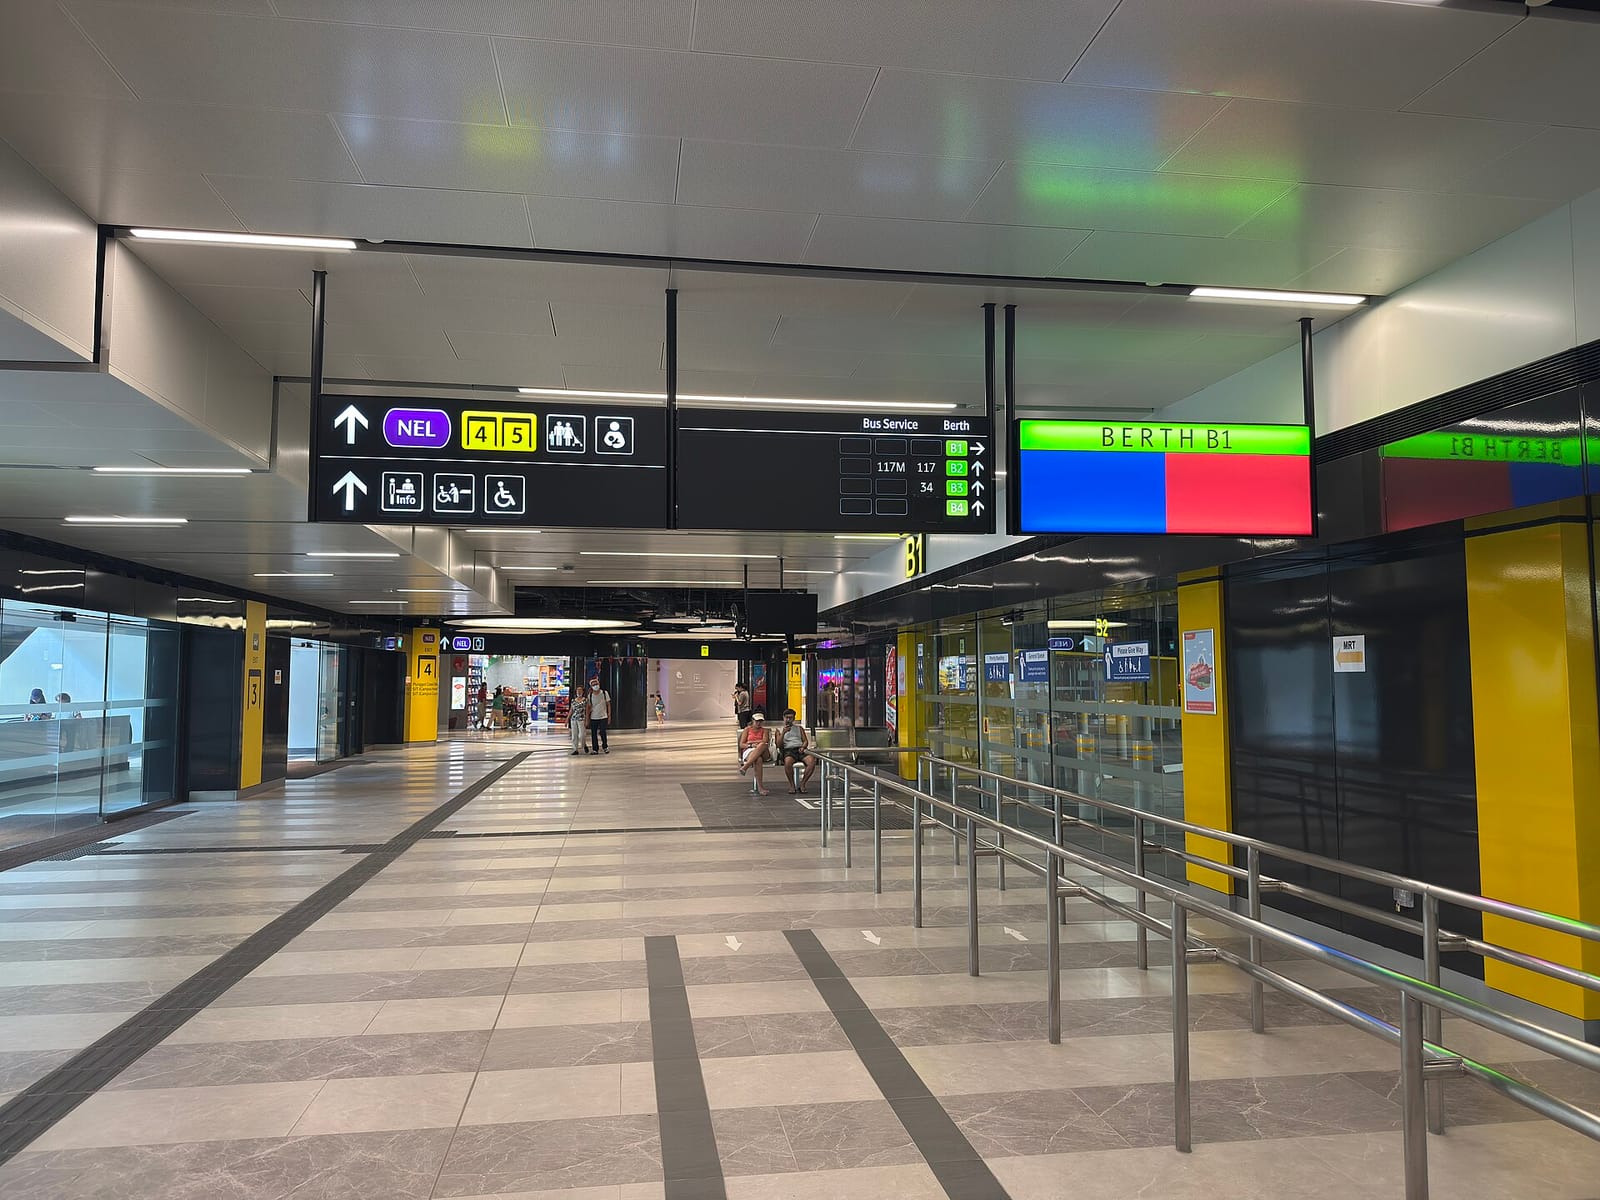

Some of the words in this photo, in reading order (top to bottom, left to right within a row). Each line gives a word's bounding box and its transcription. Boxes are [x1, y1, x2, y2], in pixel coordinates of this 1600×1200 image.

[397, 419, 436, 437] NEL
[863, 418, 881, 429] Bus
[883, 418, 919, 430] Service
[943, 420, 970, 431] Berth
[474, 426, 487, 443] 4
[511, 427, 523, 443] 5
[1102, 427, 1194, 449] BERTH
[1207, 429, 1232, 449] B1
[950, 443, 963, 454] B1
[877, 462, 906, 473] 117M
[917, 462, 936, 473] 117
[950, 463, 963, 474] B2
[920, 482, 934, 493] 34
[950, 483, 964, 493] B3
[396, 494, 416, 505] Info
[950, 503, 964, 513] B4
[905, 533, 923, 578] B1
[1343, 640, 1356, 650] MRT
[424, 664, 432, 675] 4
[252, 684, 257, 705] 3
